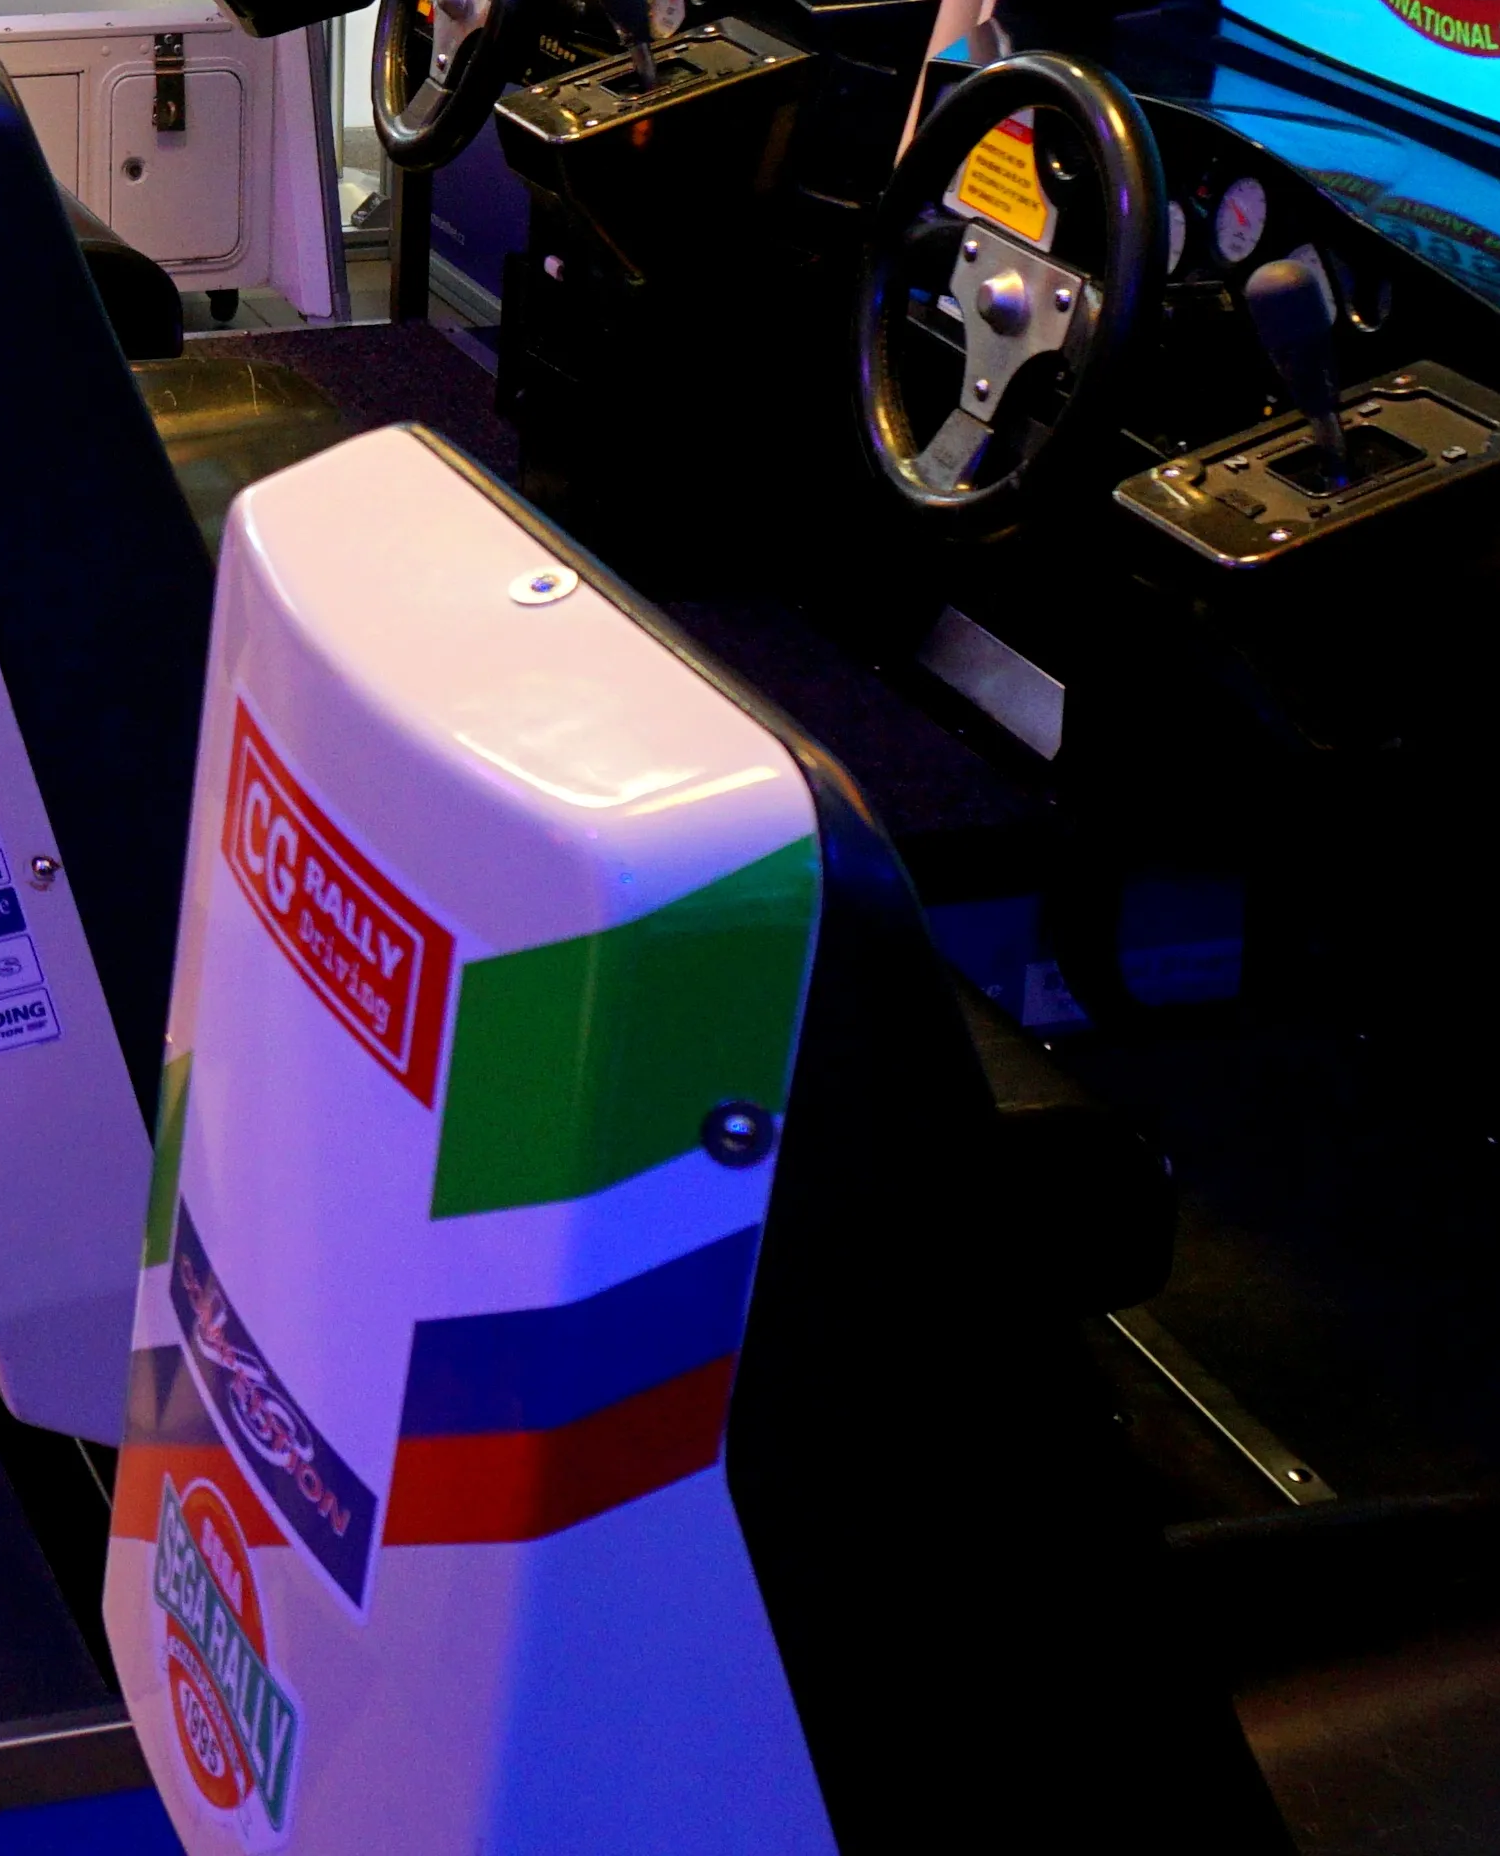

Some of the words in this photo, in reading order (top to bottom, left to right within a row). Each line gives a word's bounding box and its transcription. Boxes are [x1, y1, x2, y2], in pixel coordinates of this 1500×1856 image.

[243, 779, 299, 915] CG
[303, 855, 405, 980] RALLY
[298, 908, 392, 1036] Driving
[159, 1512, 208, 1636] SEGA
[207, 1624, 291, 1820] RALLY
[179, 1674, 220, 1776] 1995
